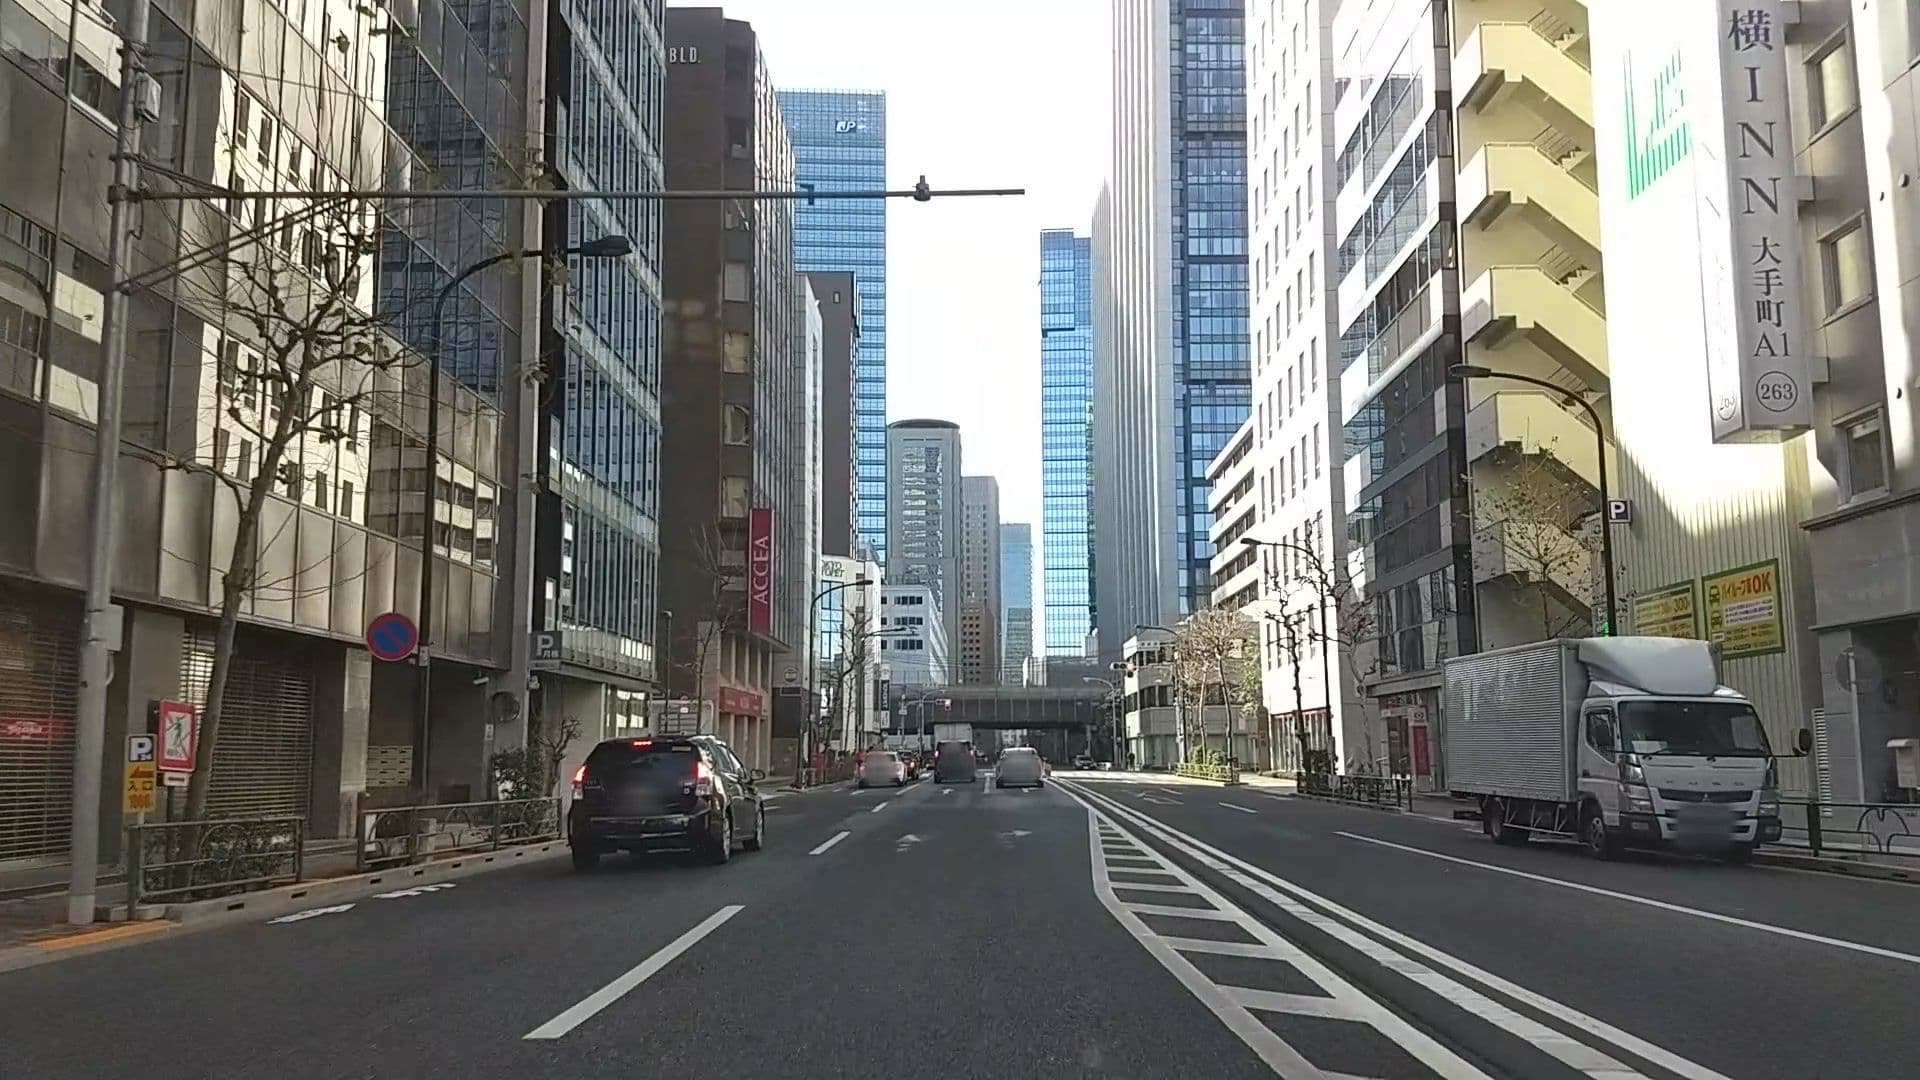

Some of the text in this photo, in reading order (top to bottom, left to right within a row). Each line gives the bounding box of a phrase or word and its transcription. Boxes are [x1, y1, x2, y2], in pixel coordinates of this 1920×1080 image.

[669, 46, 702, 64] BLD.
[1760, 383, 1794, 401] 263
[1610, 501, 1625, 519] P
[753, 535, 769, 605] ACCEA
[536, 634, 554, 656] P
[130, 737, 153, 761] P
